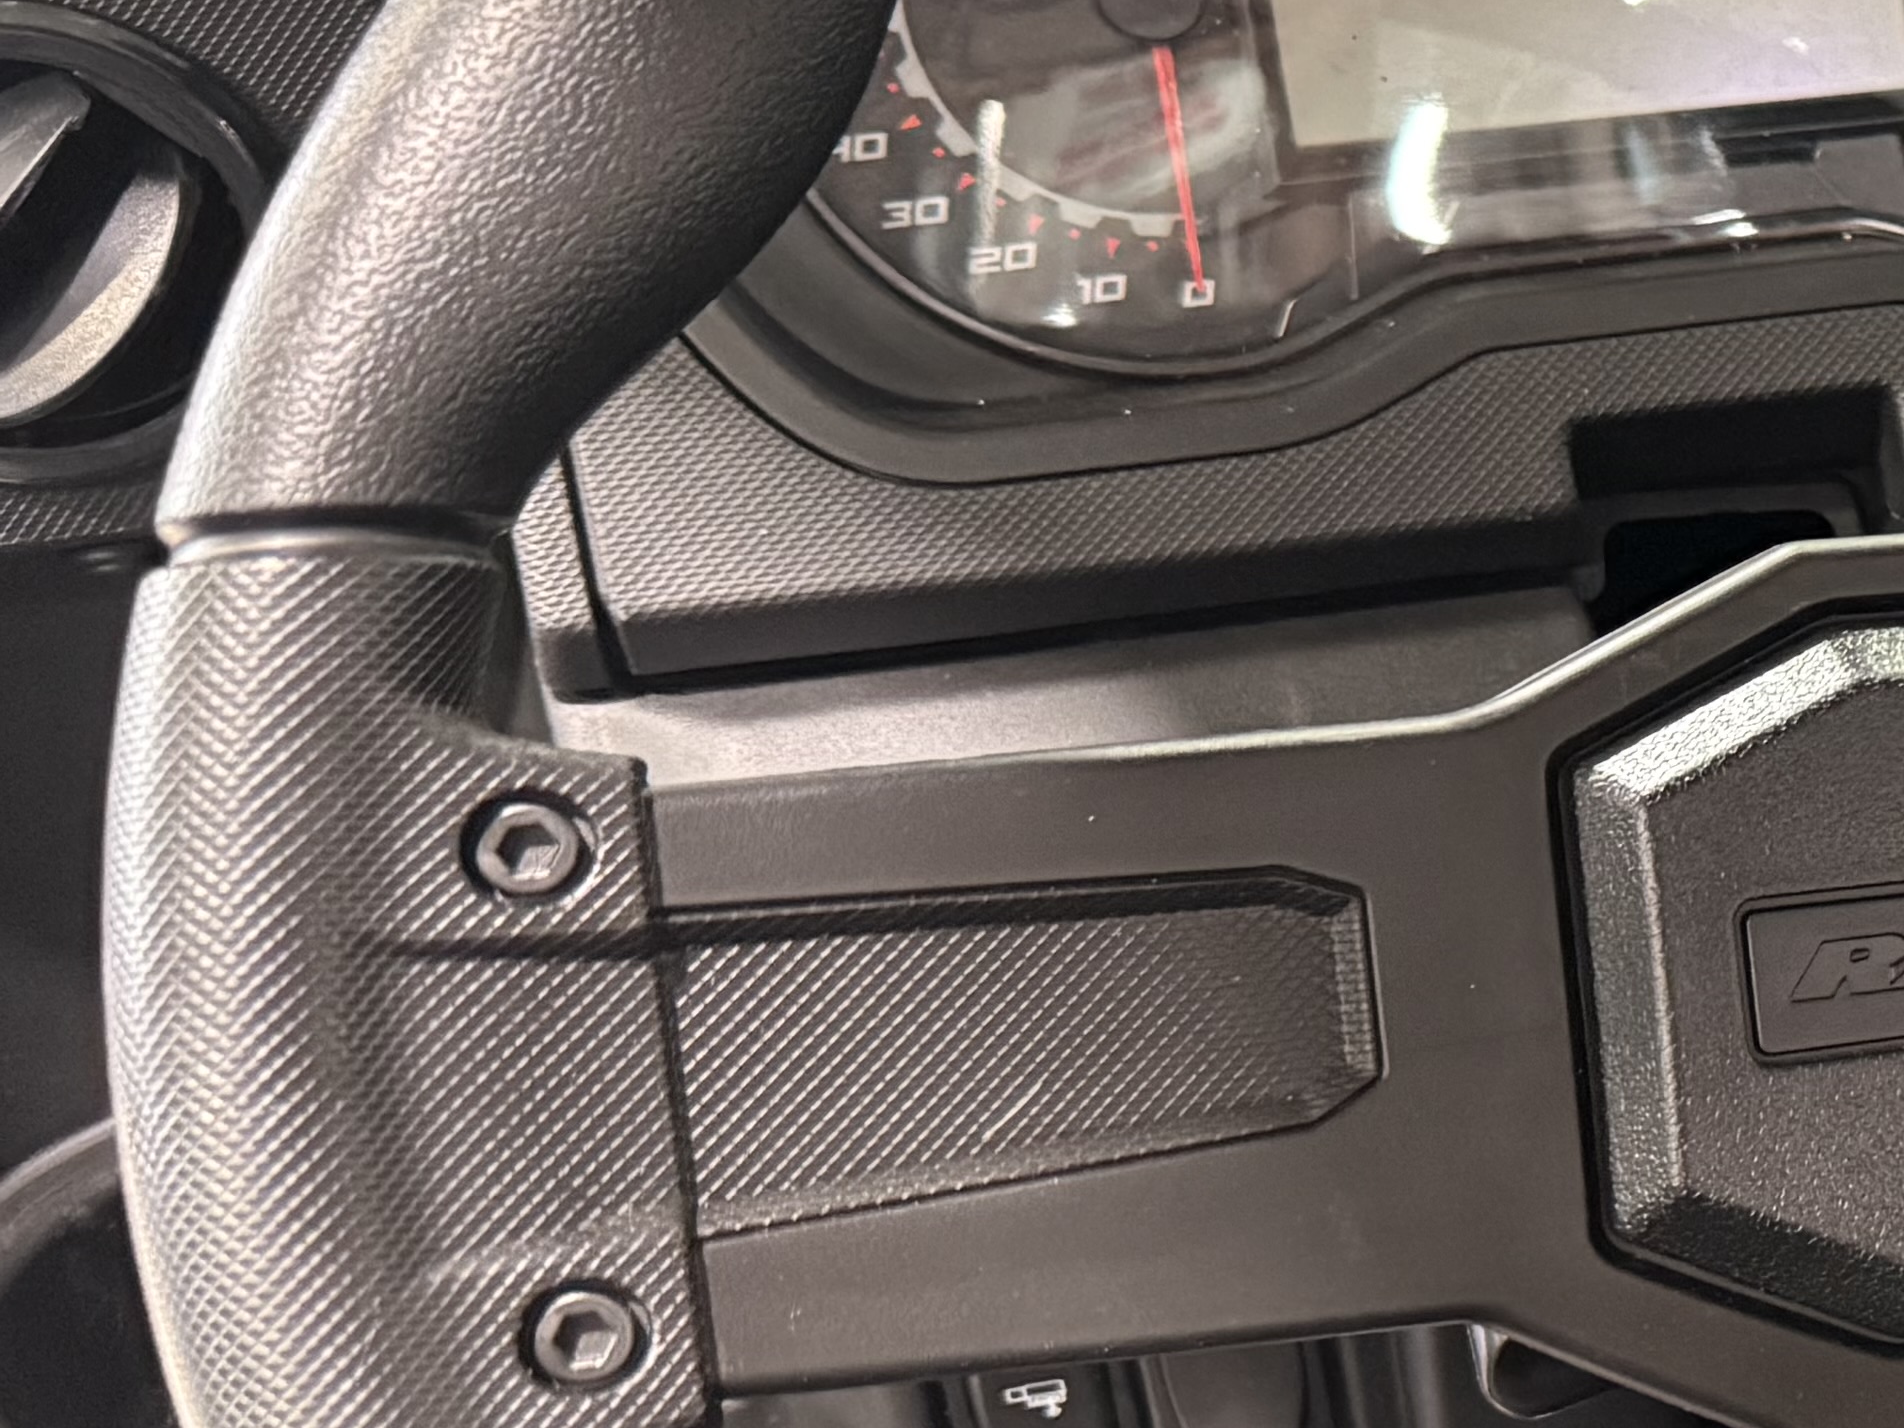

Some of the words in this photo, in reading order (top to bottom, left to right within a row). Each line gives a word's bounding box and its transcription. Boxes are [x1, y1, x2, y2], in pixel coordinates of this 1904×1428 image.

[881, 196, 949, 229] 30
[968, 241, 1037, 274] 20
[1077, 274, 1127, 304] 10
[1182, 279, 1215, 308] 0
